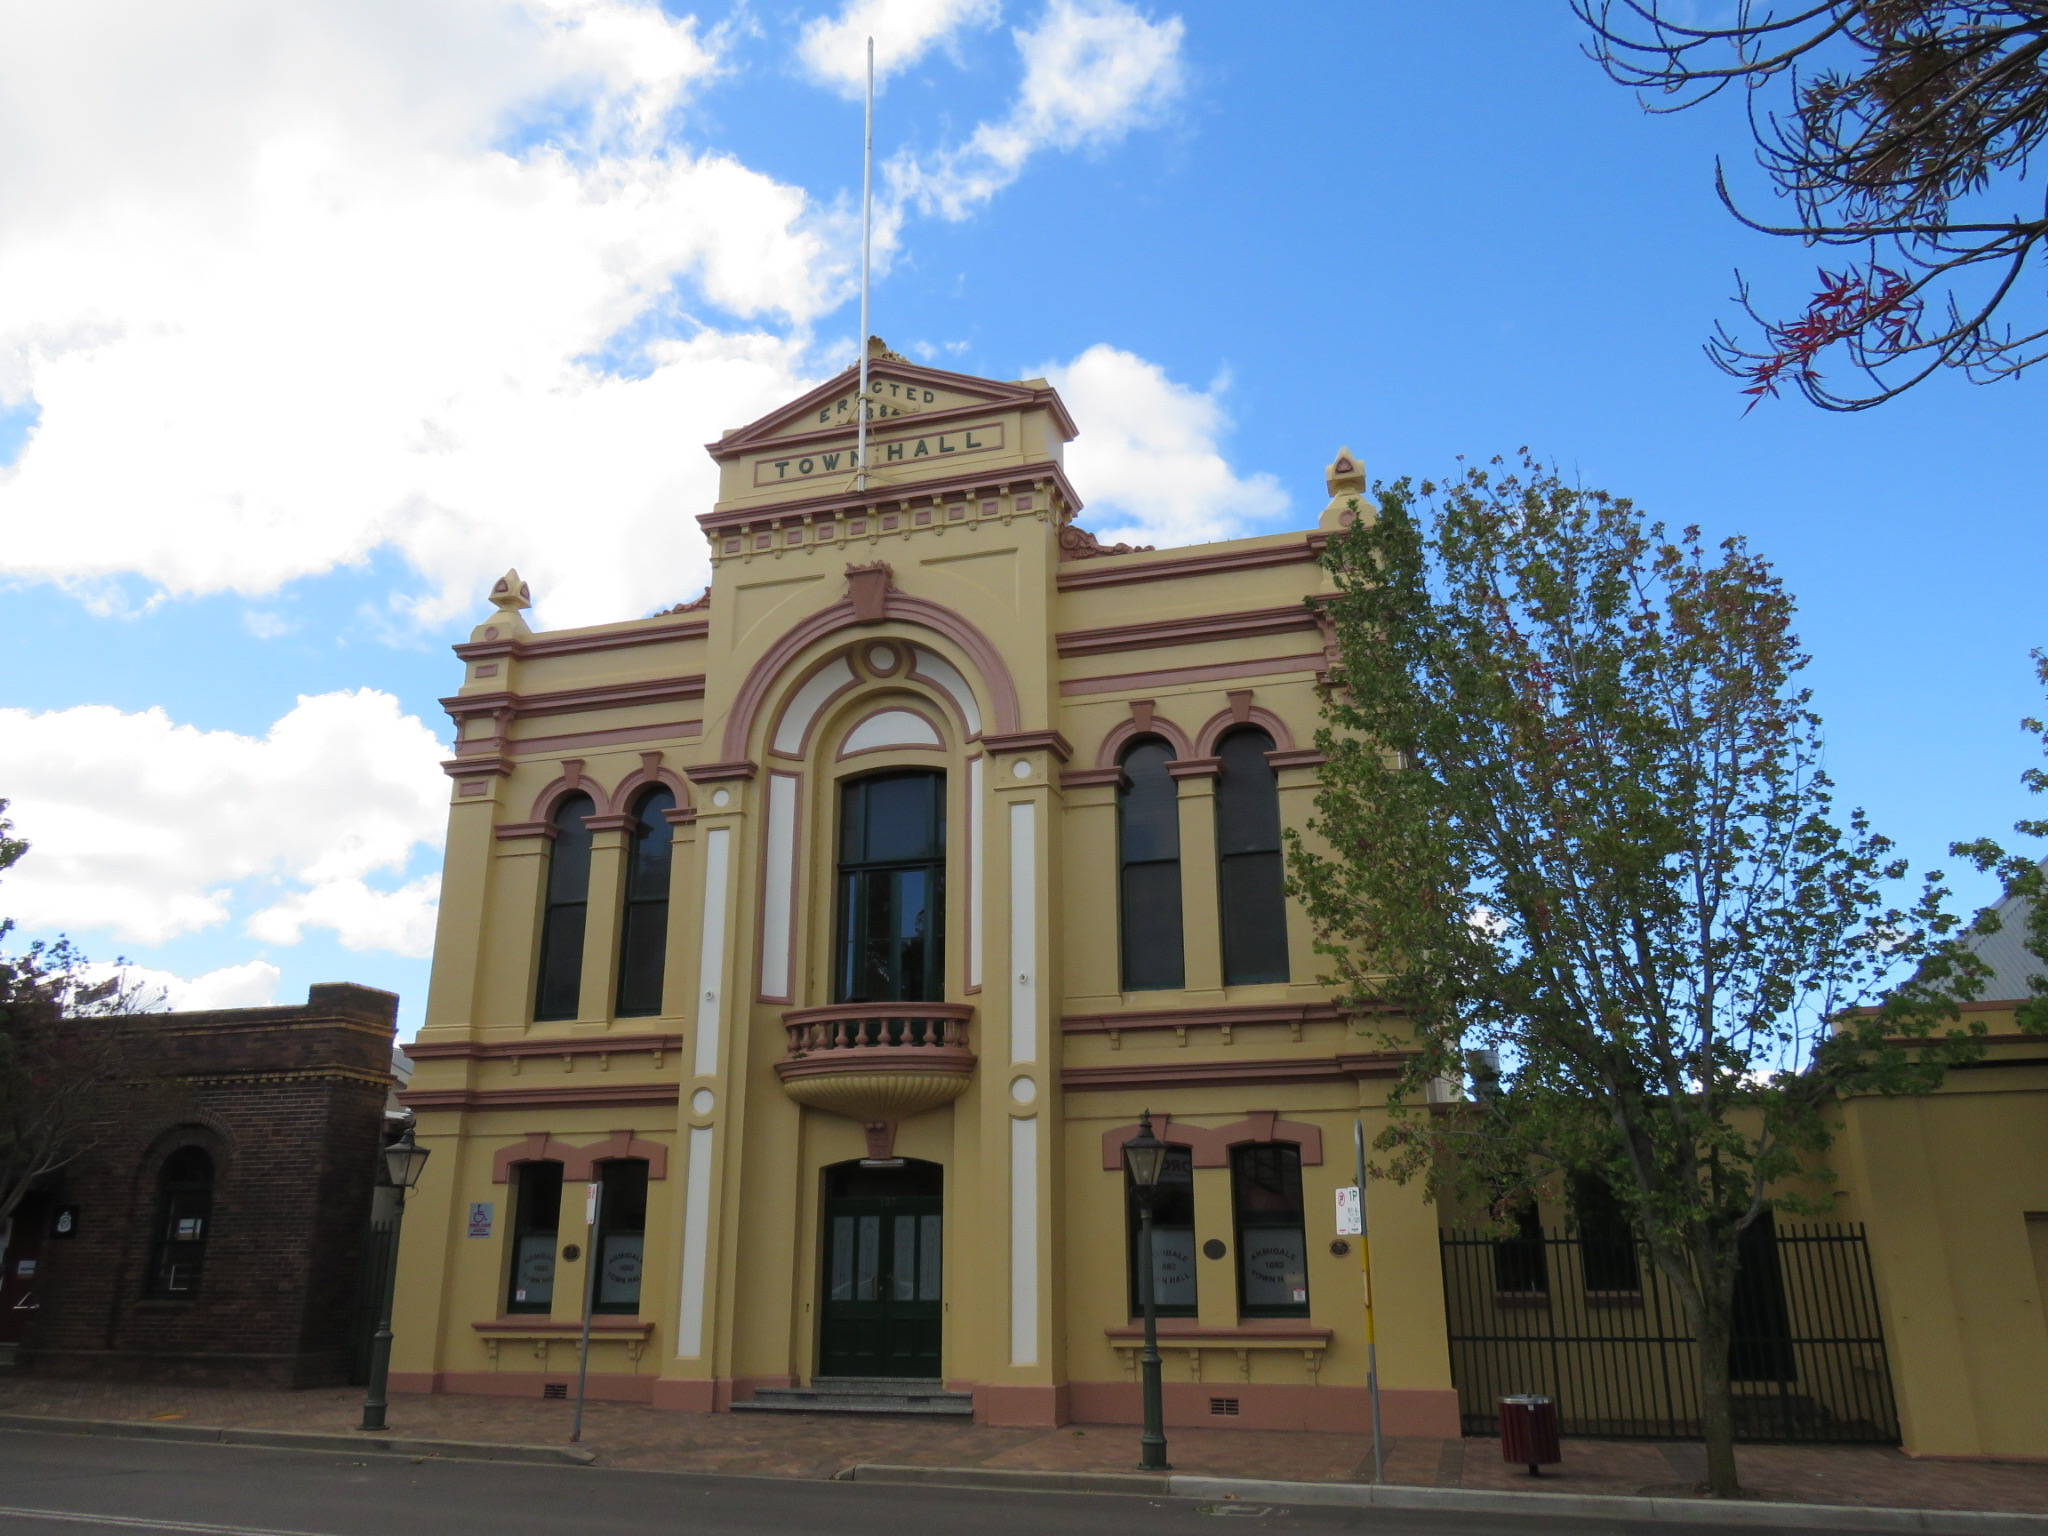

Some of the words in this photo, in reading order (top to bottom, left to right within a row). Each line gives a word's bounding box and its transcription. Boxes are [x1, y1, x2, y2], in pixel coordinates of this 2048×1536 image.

[887, 432, 982, 461] HALL
[1251, 1248, 1296, 1262] ARMIDALE
[1265, 1261, 1284, 1269] 1882
[1251, 1269, 1276, 1283] TOWN
